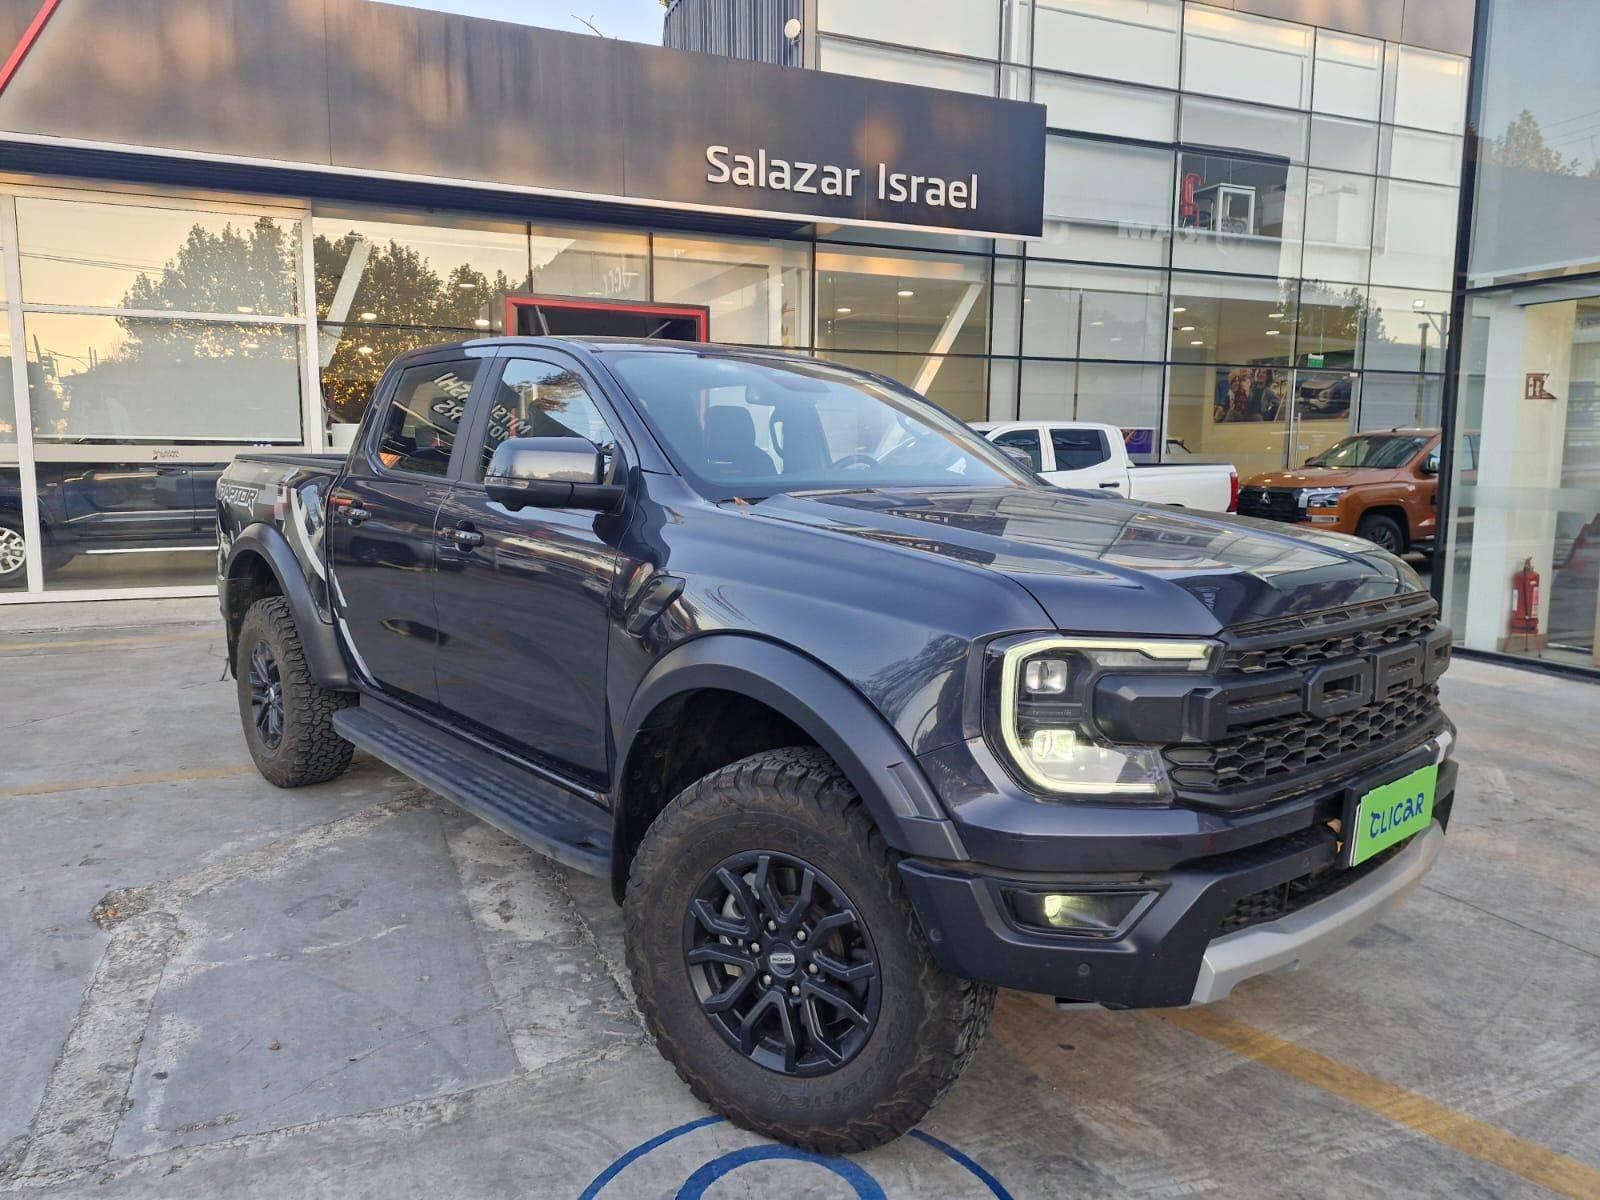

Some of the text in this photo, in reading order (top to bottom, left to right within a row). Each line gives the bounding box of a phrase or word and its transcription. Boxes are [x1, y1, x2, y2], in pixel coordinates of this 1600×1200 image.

[706, 145, 978, 210] Salazar Israel
[219, 483, 259, 517] RAPTOR
